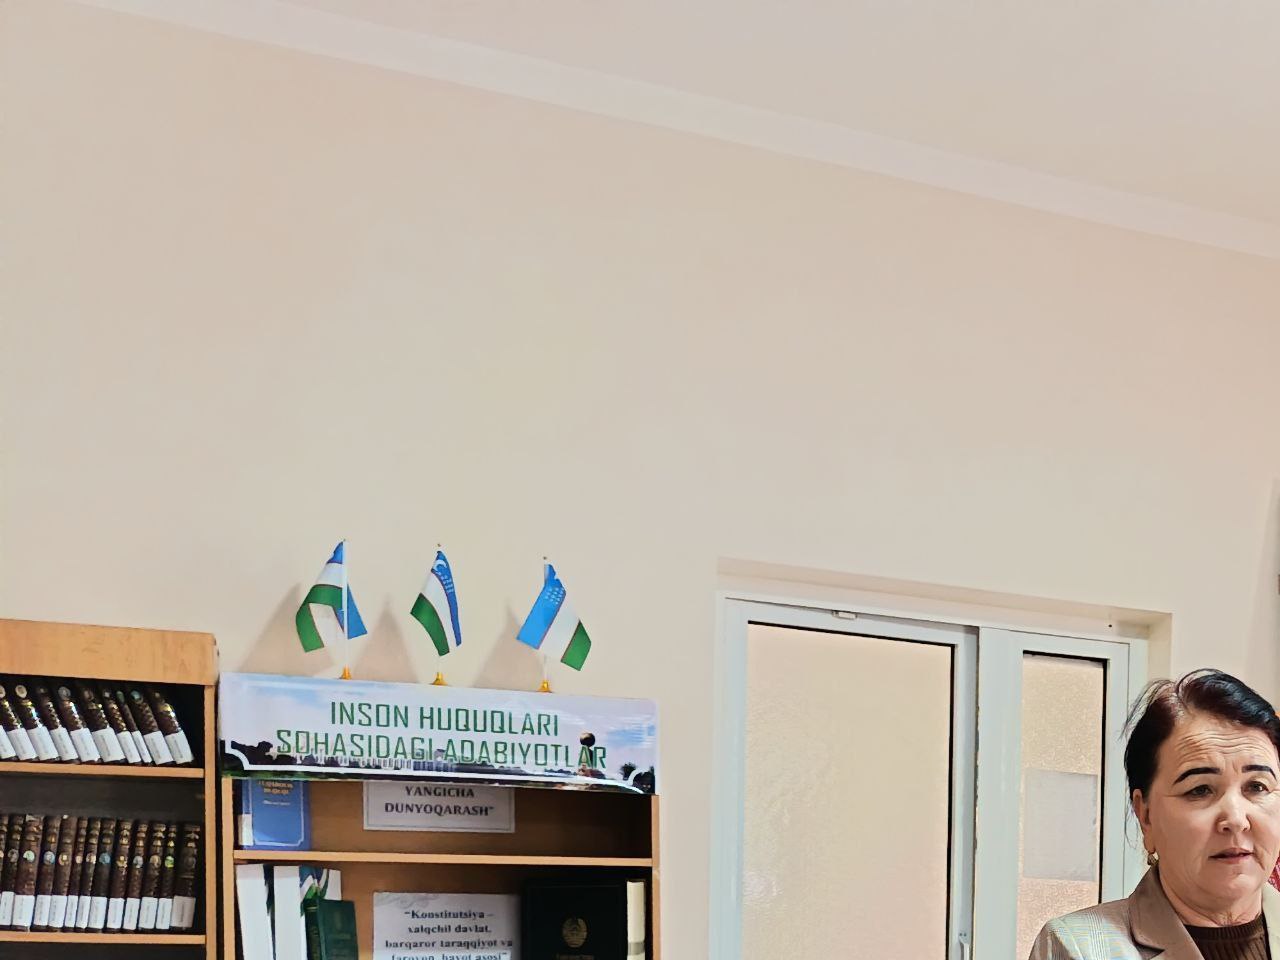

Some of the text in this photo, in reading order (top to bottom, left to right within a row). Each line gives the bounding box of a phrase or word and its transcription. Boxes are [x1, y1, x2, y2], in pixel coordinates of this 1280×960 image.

[331, 701, 558, 737] INSON HUQUQLARI
[276, 729, 606, 769] SOHASIDAGI ADABIYOTLAR
[404, 785, 475, 799] YANGICHA
